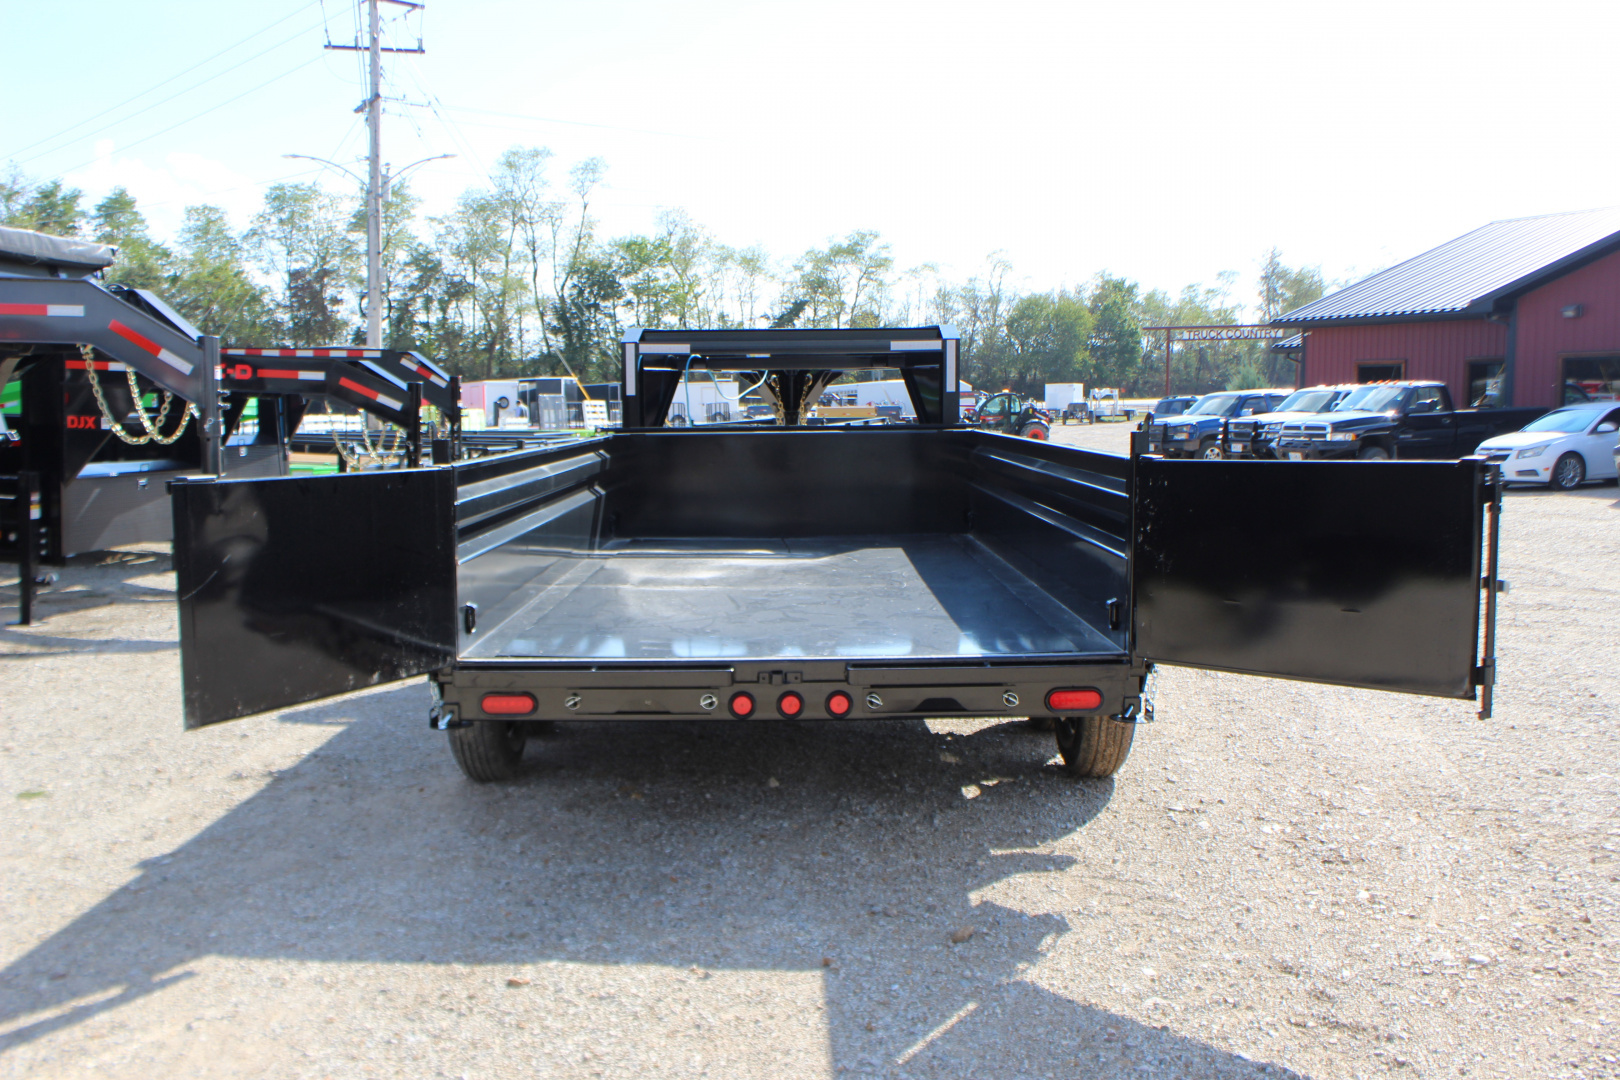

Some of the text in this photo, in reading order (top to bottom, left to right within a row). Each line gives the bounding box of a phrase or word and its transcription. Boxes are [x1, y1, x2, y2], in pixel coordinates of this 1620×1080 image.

[1187, 328, 1280, 340] TRUCK COUNTRY
[66, 415, 96, 429] DJX
